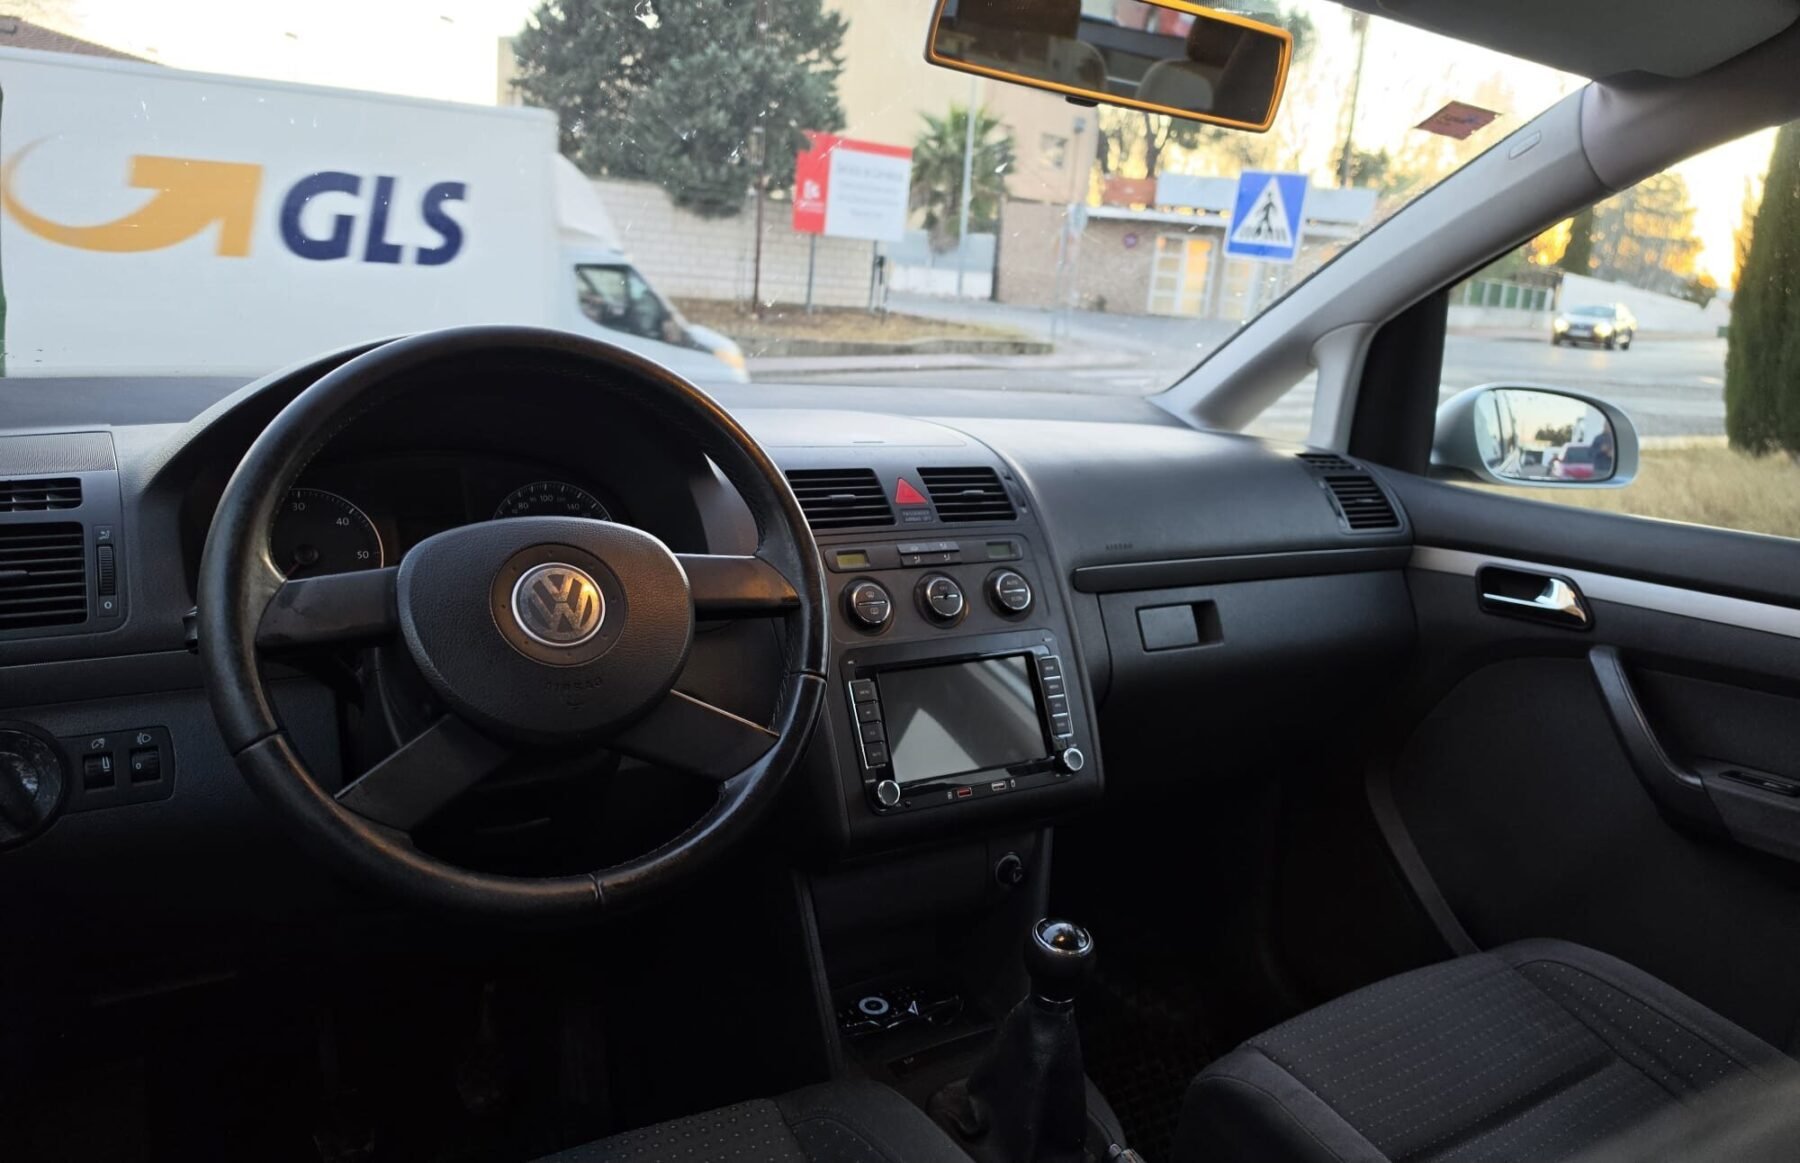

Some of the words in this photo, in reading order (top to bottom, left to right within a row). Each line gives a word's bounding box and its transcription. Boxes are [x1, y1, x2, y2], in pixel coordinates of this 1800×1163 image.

[278, 171, 466, 266] GLS
[292, 502, 306, 511] 30
[336, 517, 350, 526] 40
[356, 550, 369, 559] 50
